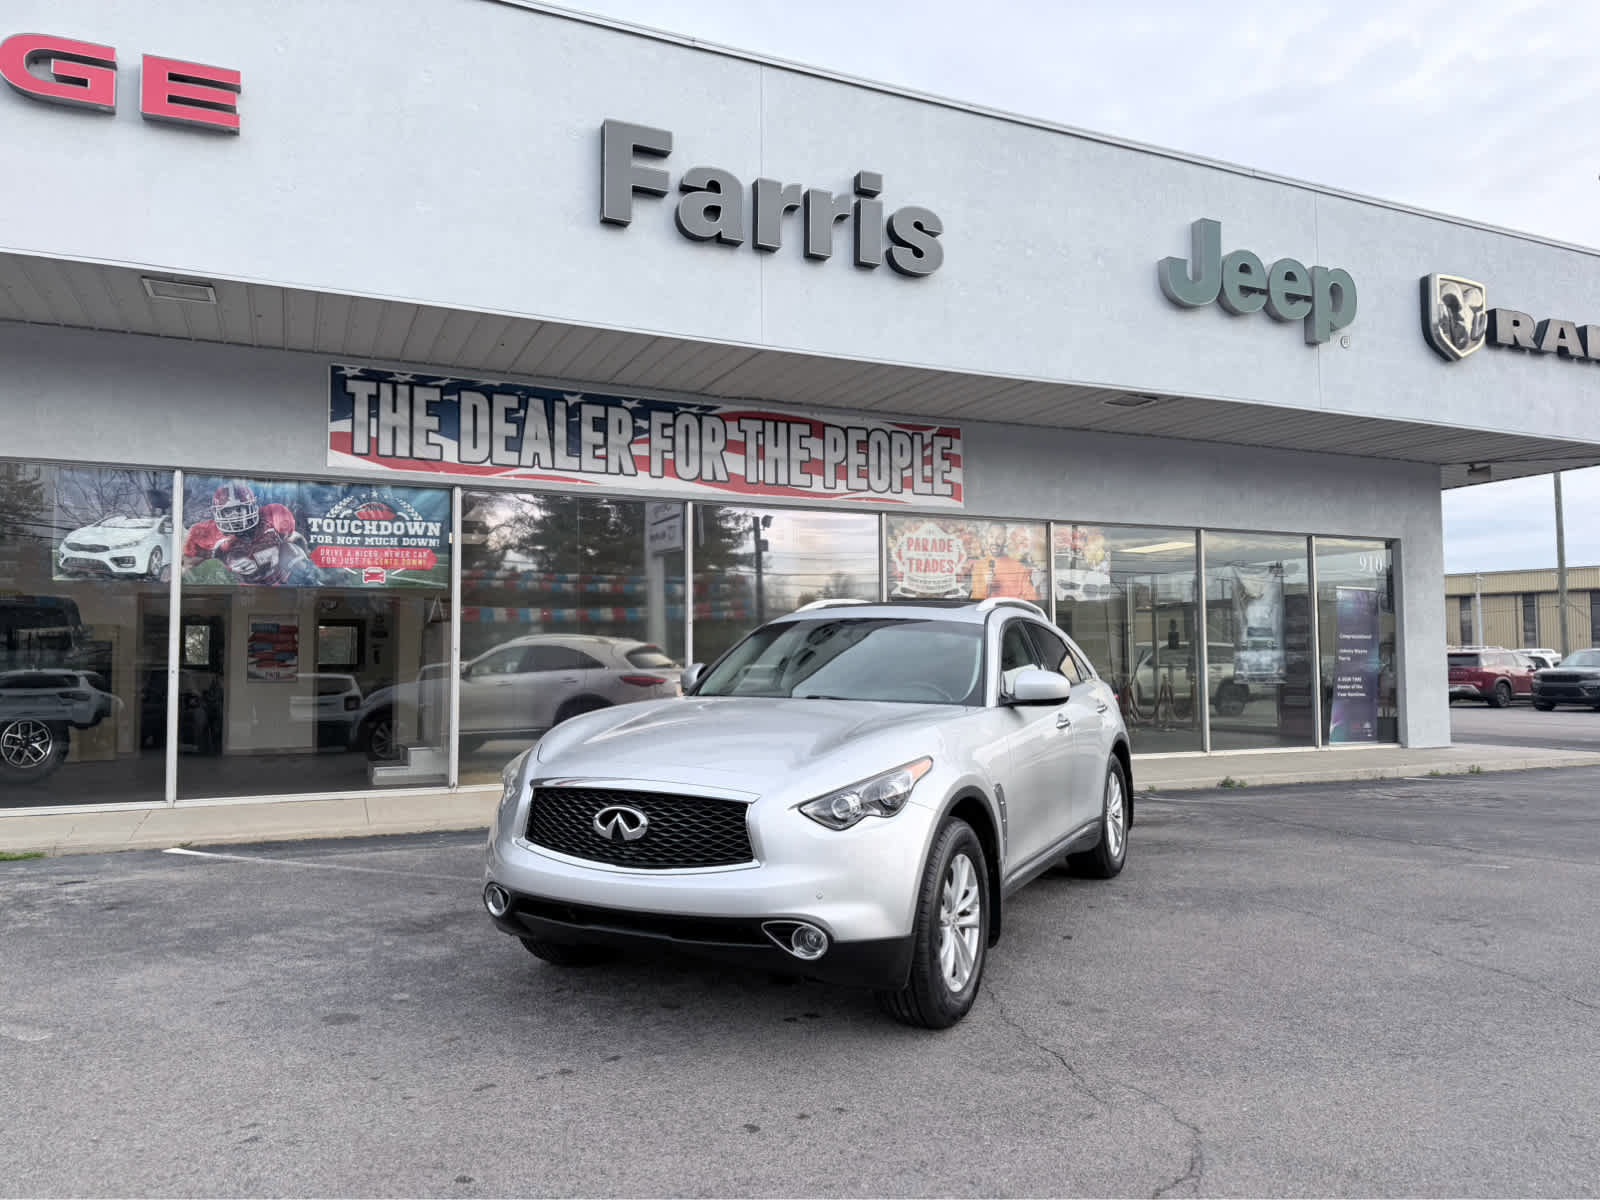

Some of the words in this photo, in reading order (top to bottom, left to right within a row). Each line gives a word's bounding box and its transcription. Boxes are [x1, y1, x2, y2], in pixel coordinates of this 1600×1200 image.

[0, 33, 241, 136] GE
[600, 118, 944, 278] Farris
[1158, 217, 1357, 345] Jeep
[346, 378, 444, 461] THE
[457, 389, 638, 477] DEALER
[649, 410, 729, 483] FOR
[739, 417, 813, 488] THE
[823, 423, 953, 497] PEOPLE
[307, 518, 442, 537] TOUCHDOWN
[309, 535, 333, 544] FOR
[336, 536, 361, 546] NOT
[365, 537, 398, 547] MUCH
[402, 538, 440, 547] DOWN!
[906, 537, 955, 553] PARADE
[321, 557, 337, 565] FOR
[906, 558, 955, 574] TRADES
[1359, 555, 1383, 573] 910
